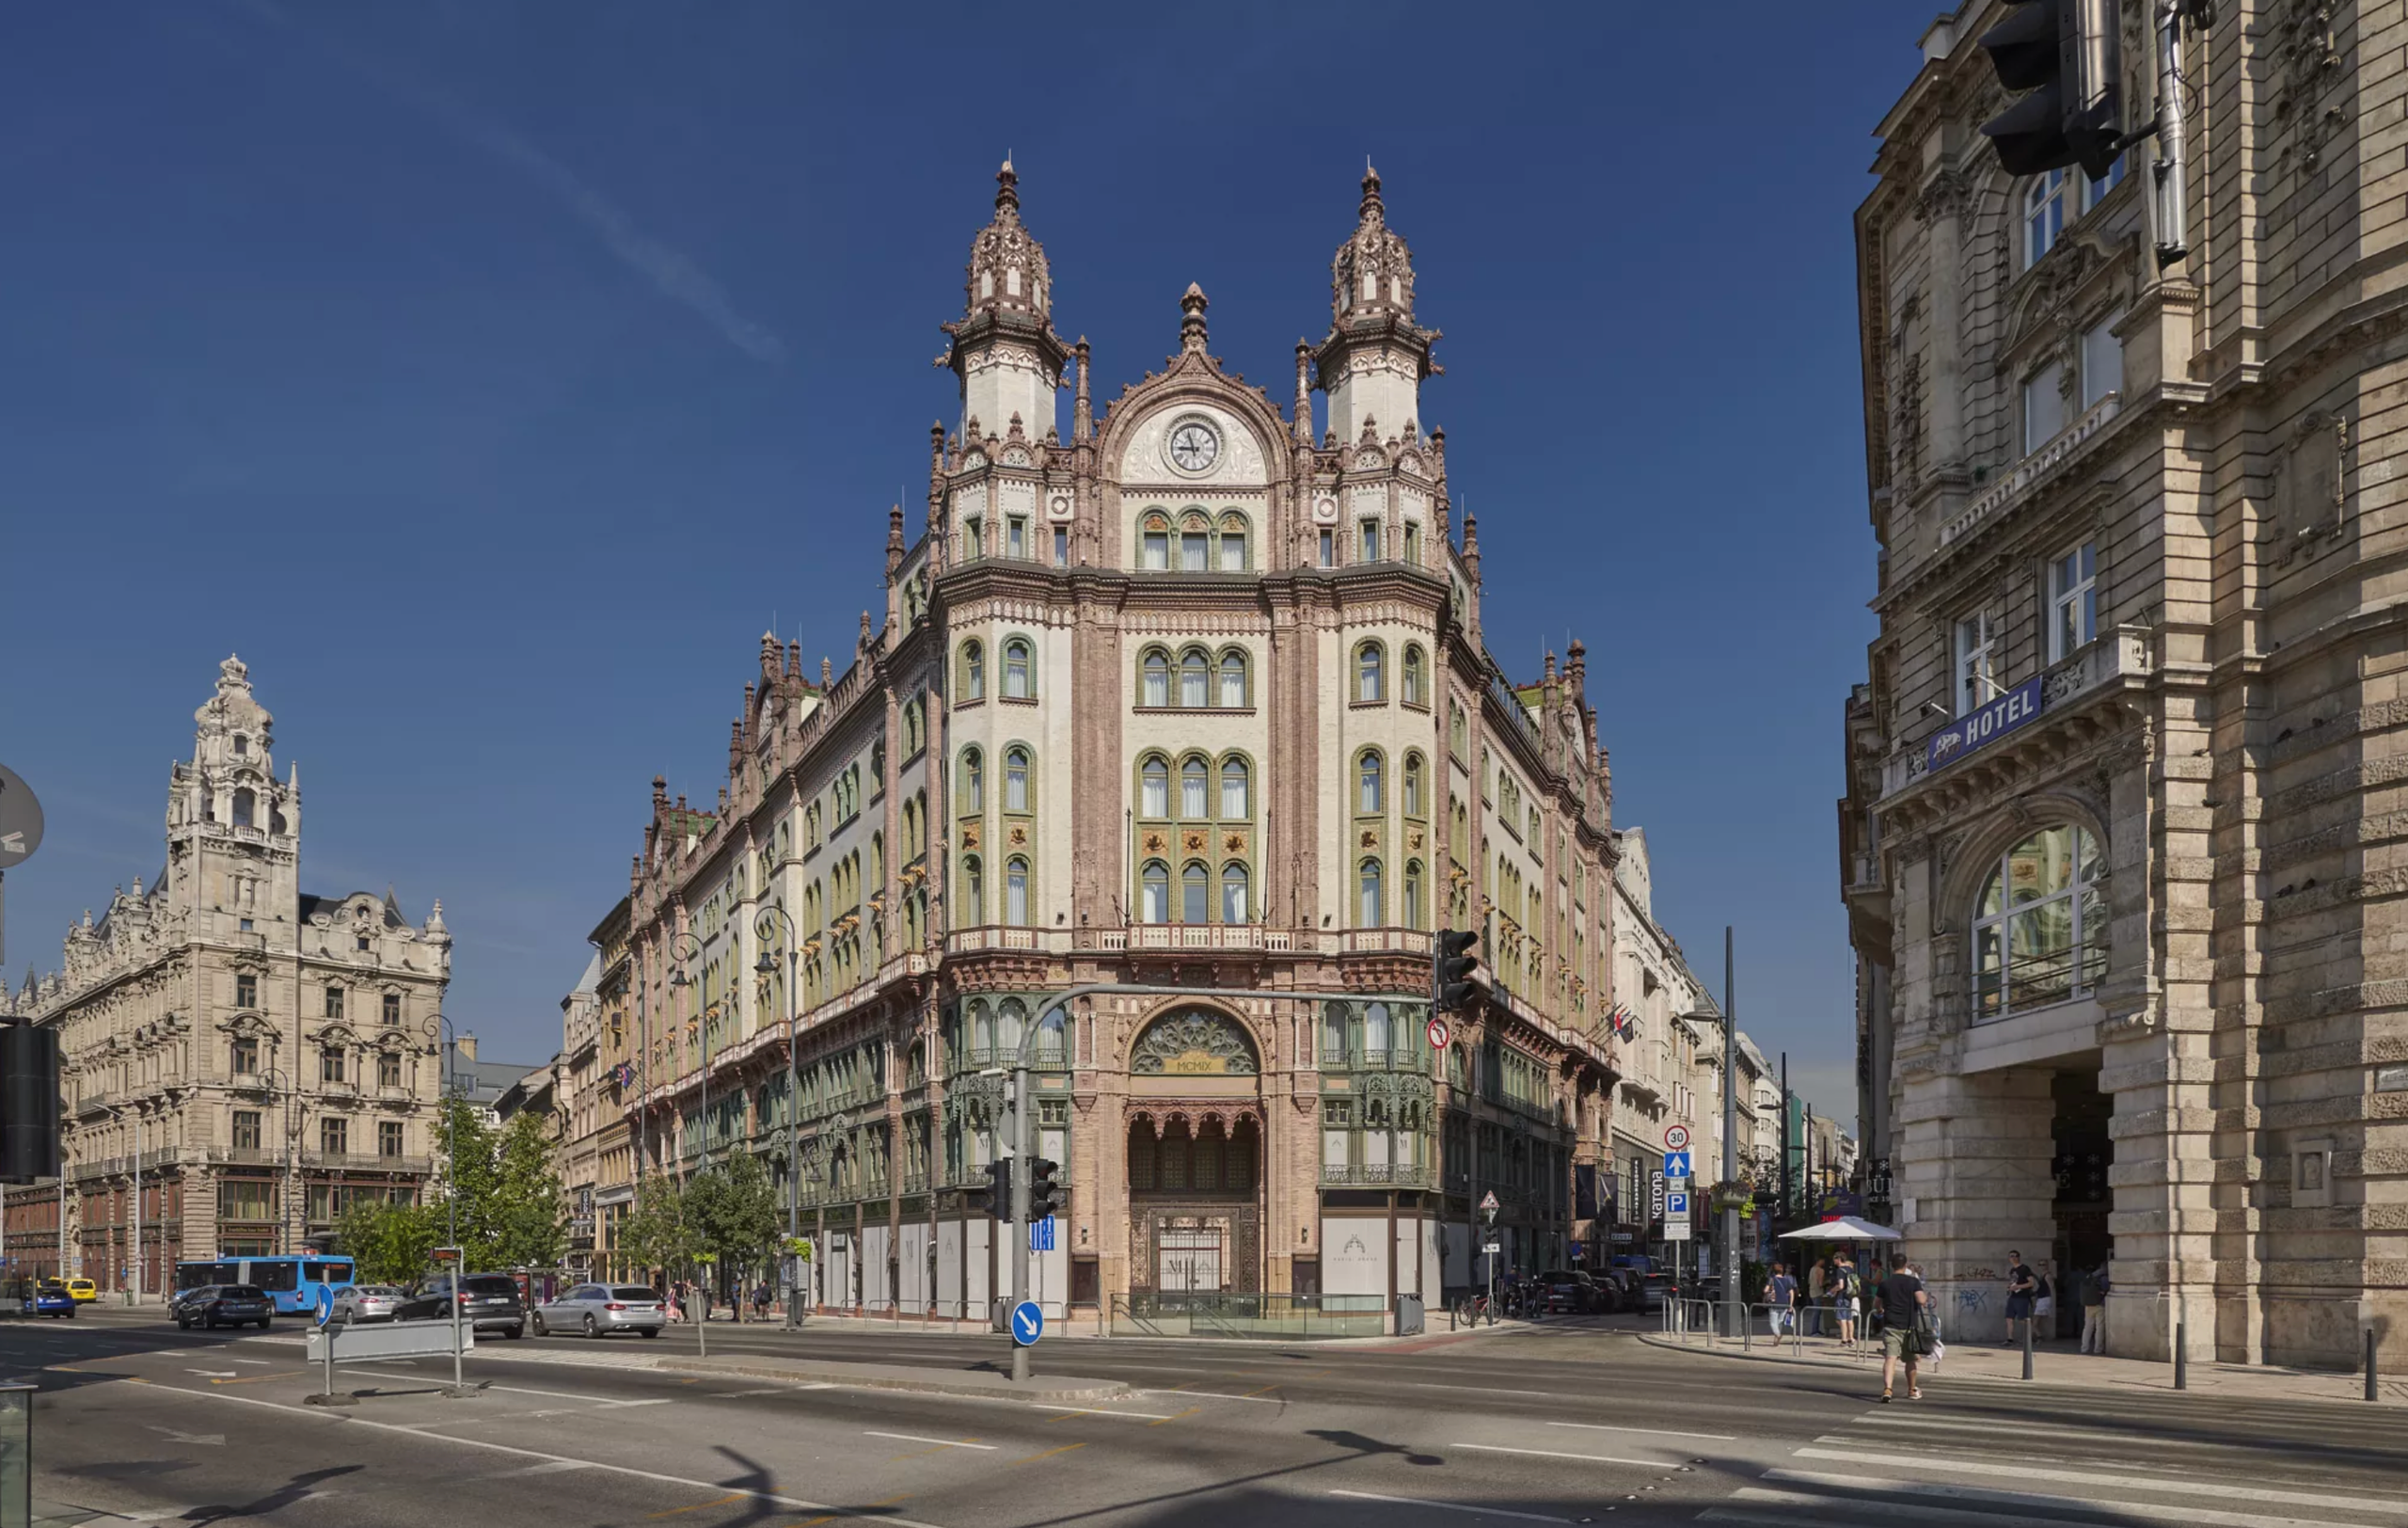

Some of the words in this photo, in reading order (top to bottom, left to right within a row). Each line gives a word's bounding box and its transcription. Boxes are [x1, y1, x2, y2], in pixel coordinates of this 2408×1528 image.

[1967, 690, 2033, 746] HOTEL
[1177, 1061, 1212, 1072] MCMIX
[1670, 1133, 1684, 1143] 30
[1671, 1195, 1683, 1212] P
